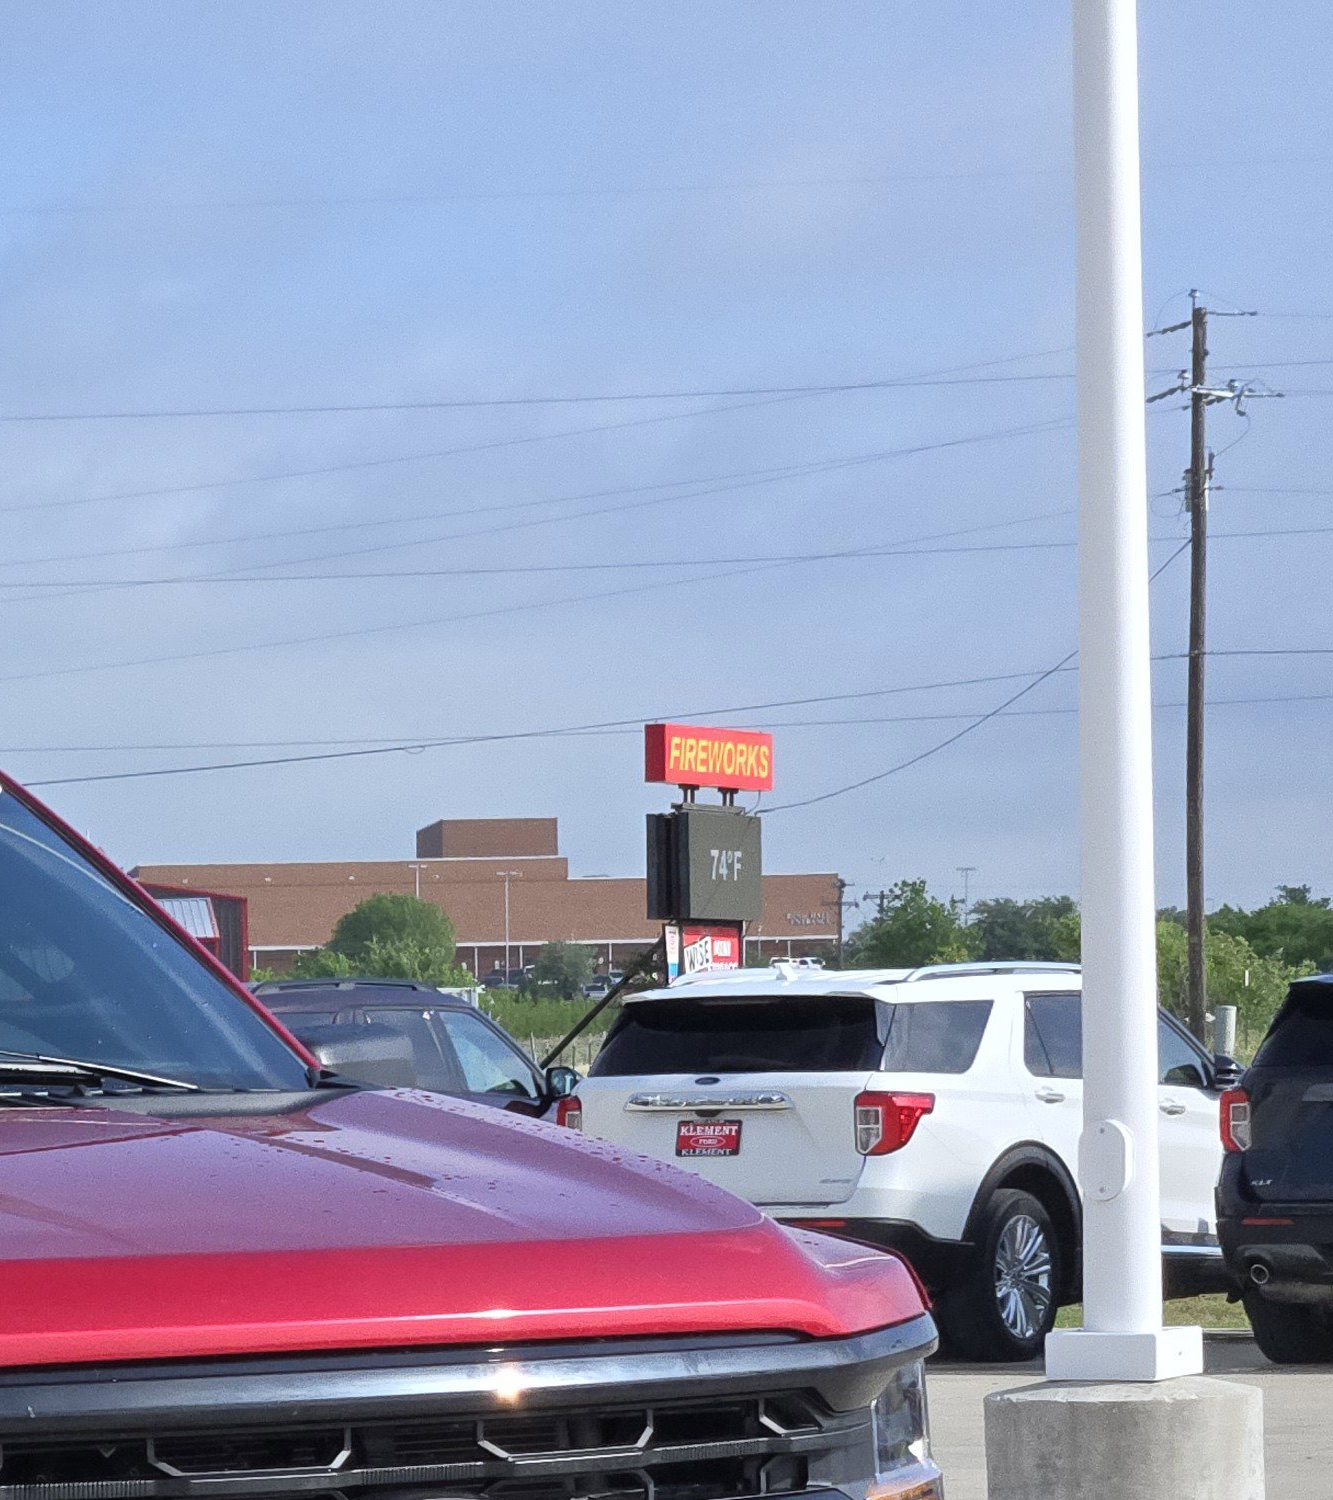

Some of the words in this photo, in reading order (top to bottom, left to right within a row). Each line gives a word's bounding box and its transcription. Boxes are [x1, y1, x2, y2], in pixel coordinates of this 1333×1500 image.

[669, 736, 770, 779] FIREWORKS
[680, 1124, 739, 1136] KLEMENT
[681, 1148, 733, 1156] KLEMENT
